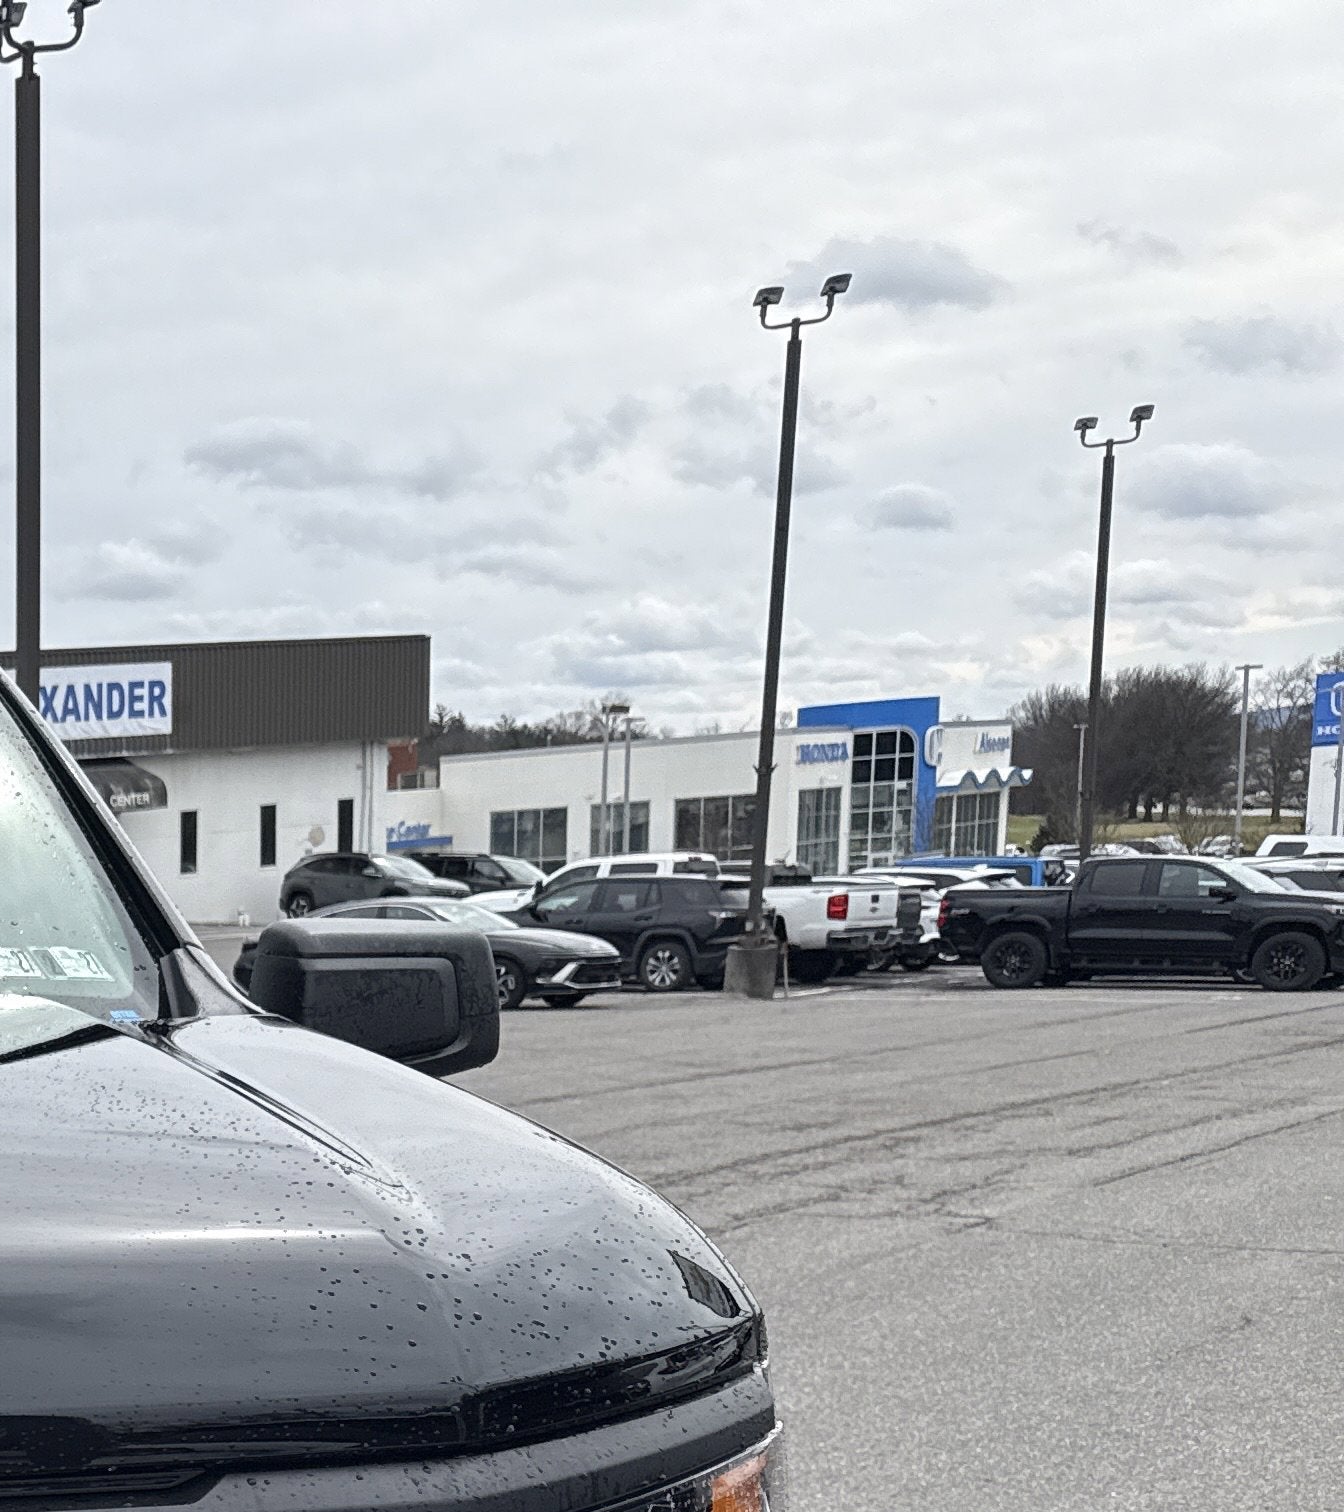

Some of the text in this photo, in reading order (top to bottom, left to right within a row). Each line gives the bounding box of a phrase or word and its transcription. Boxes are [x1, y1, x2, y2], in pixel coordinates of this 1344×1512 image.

[39, 680, 167, 724] XANDER
[797, 742, 849, 764] HONDA
[110, 791, 150, 807] CENTER
